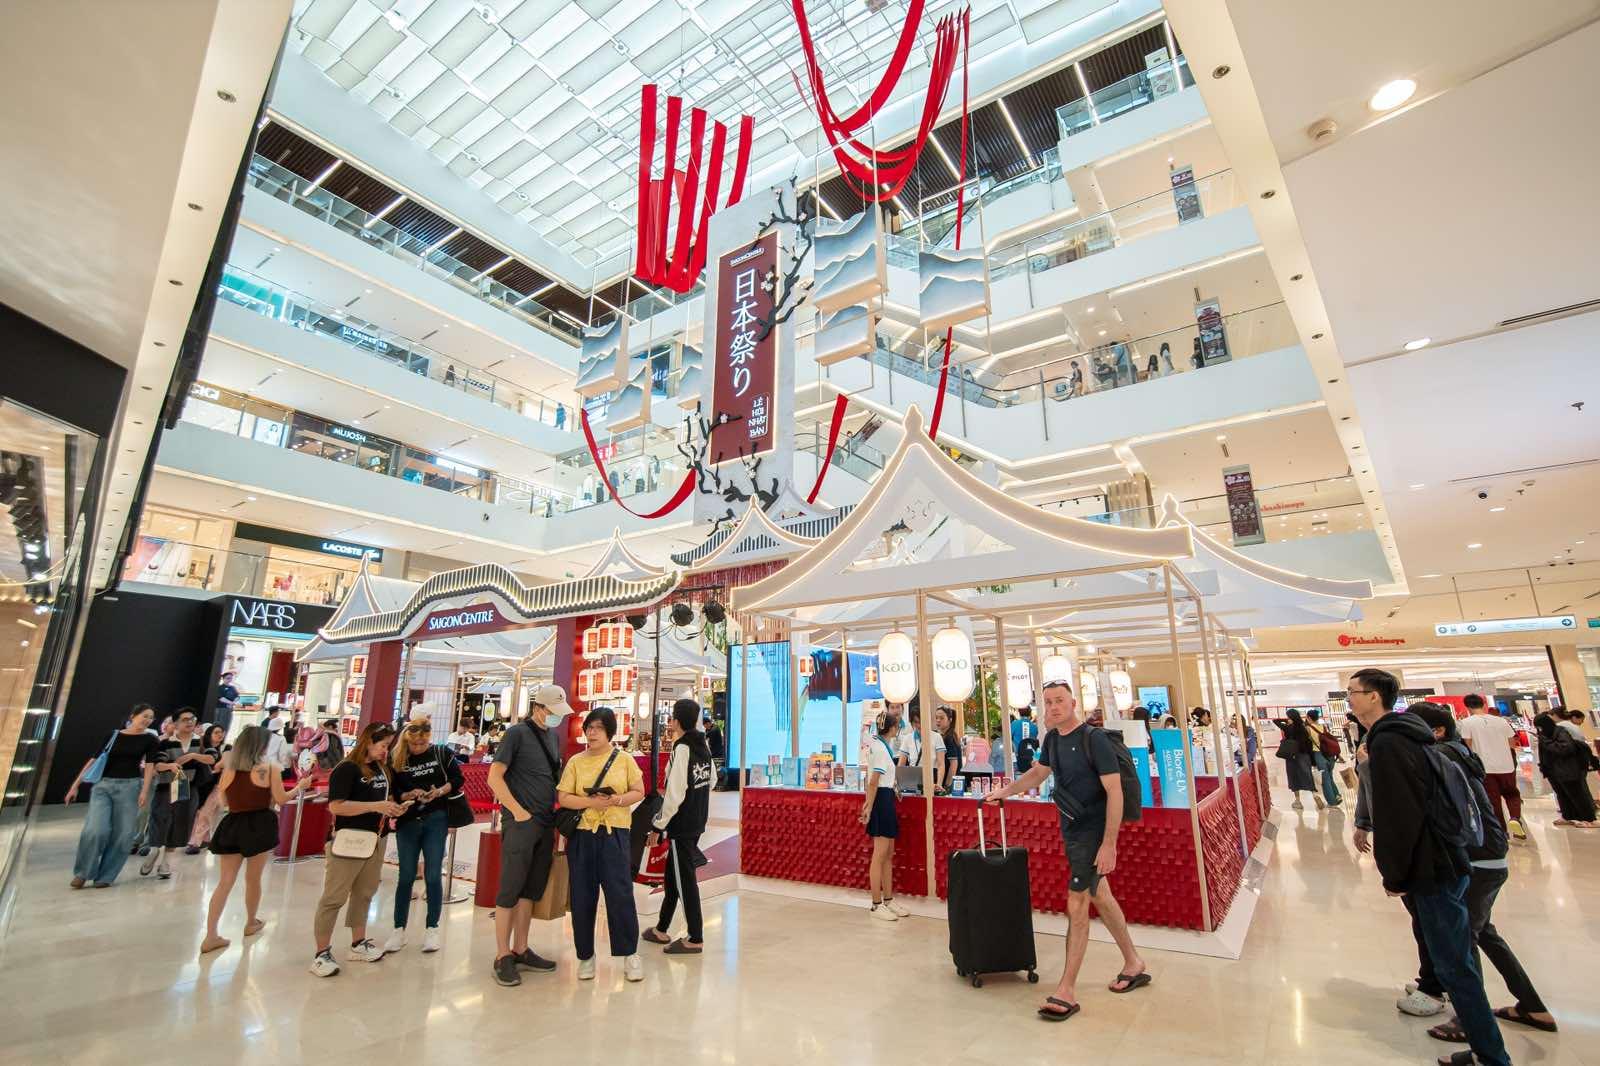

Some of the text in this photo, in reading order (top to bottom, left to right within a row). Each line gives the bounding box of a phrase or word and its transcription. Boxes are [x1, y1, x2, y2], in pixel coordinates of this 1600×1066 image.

[729, 268, 759, 398] 日本祭り
[332, 427, 366, 442] MUJOSH
[322, 542, 362, 556] LACOSTE
[231, 599, 296, 630] NARS
